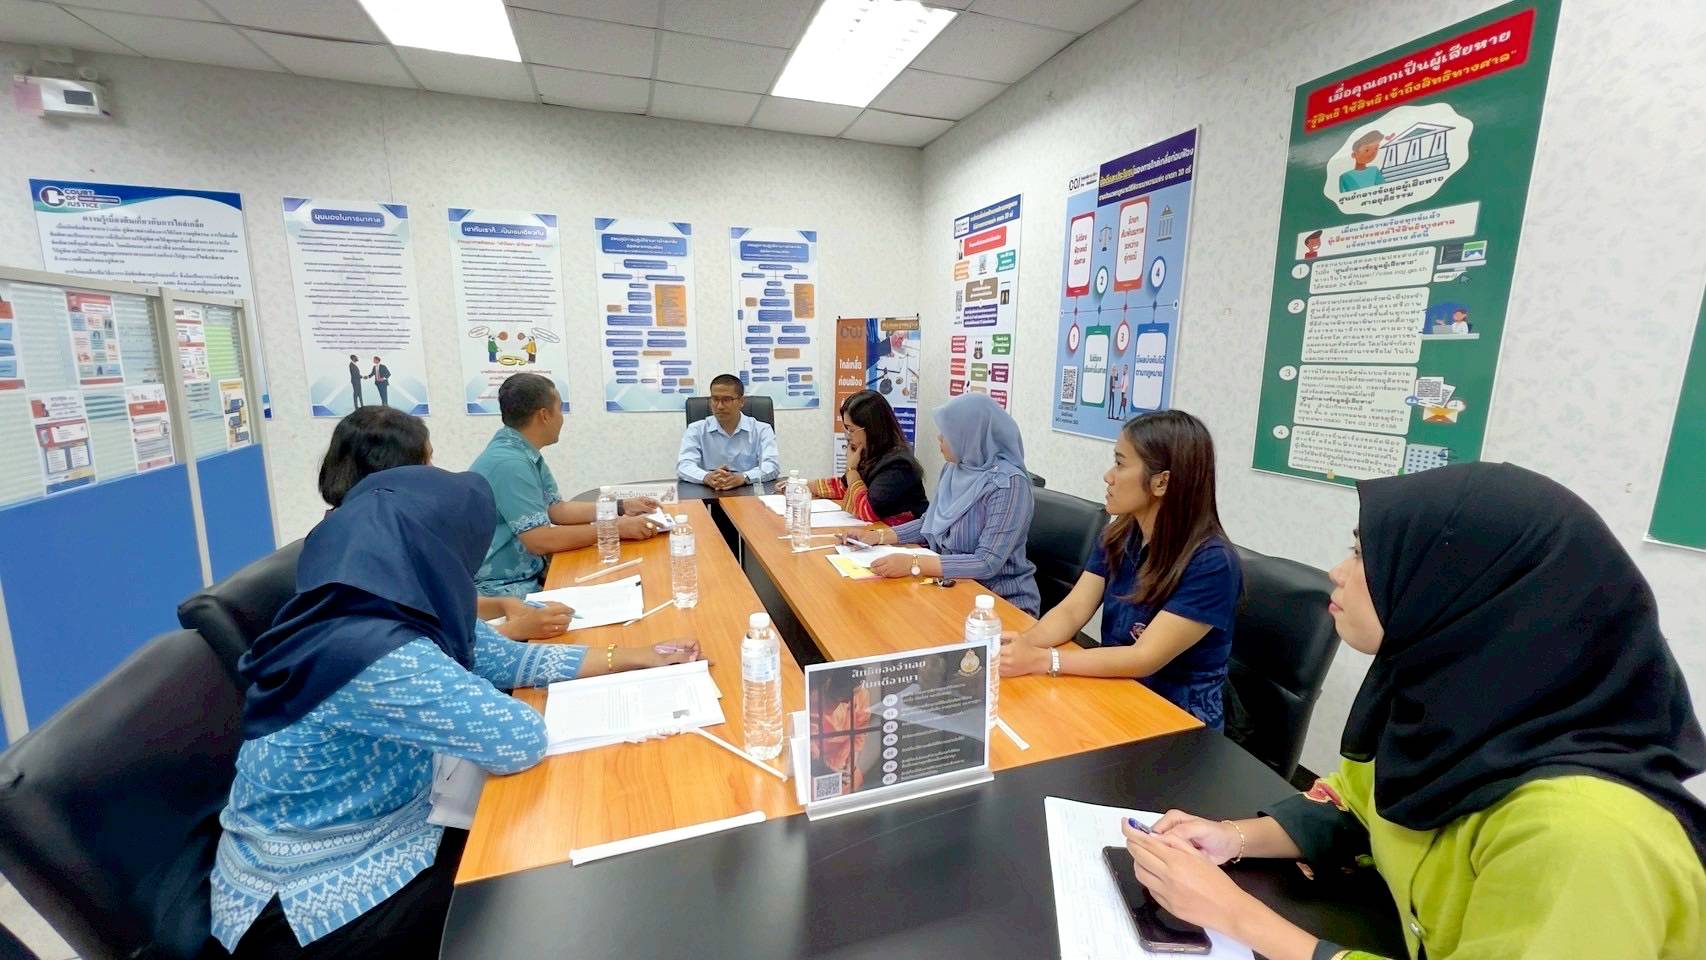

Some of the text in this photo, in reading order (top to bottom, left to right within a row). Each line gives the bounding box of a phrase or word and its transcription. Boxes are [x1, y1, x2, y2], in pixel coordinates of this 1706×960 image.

[1328, 30, 1512, 103] เมื่อคุณตกเป็นผู้เสียหาย
[1293, 302, 1300, 310] 2
[839, 376, 863, 386] ก่อนฟ้อง
